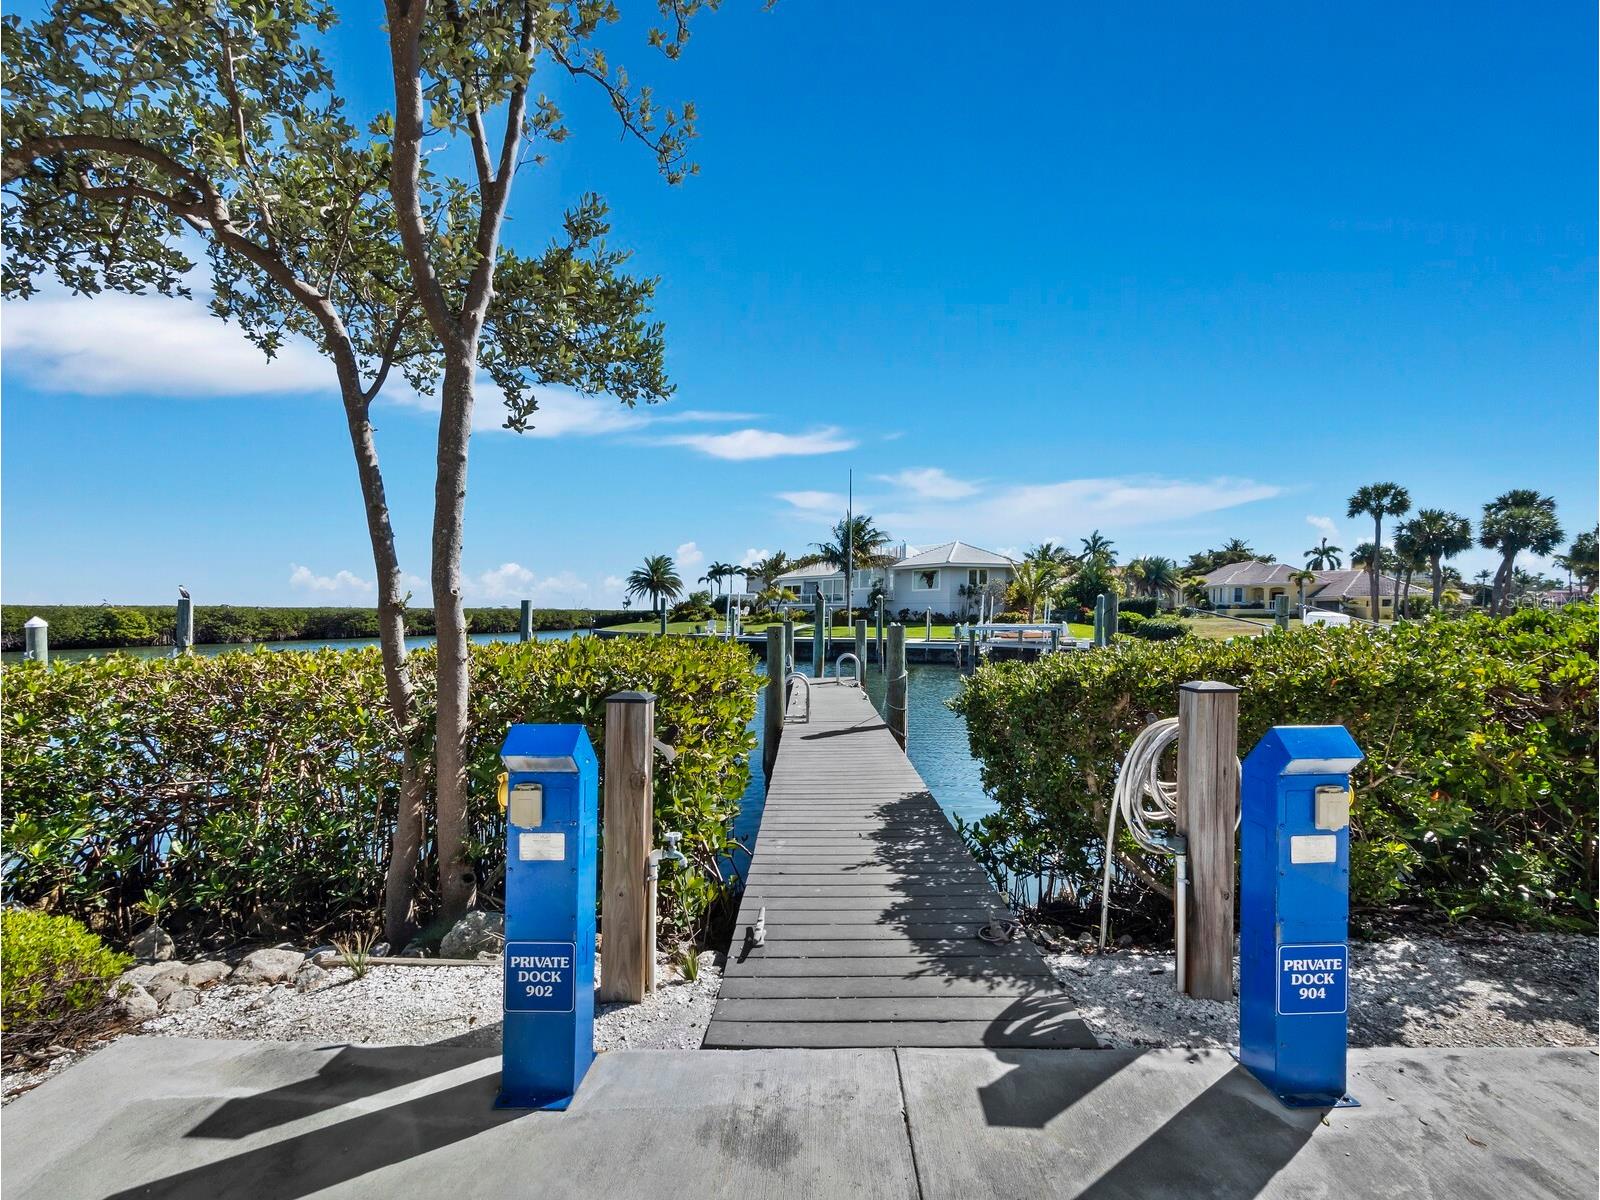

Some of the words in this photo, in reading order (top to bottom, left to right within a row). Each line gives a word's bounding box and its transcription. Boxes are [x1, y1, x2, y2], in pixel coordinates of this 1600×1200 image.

[510, 956, 570, 968] PRIVATE
[1283, 958, 1343, 971] PRIVATE
[518, 970, 562, 983] DOCK
[1291, 973, 1335, 986] DOCK
[525, 985, 553, 997] 902
[1299, 987, 1327, 1000] 904
